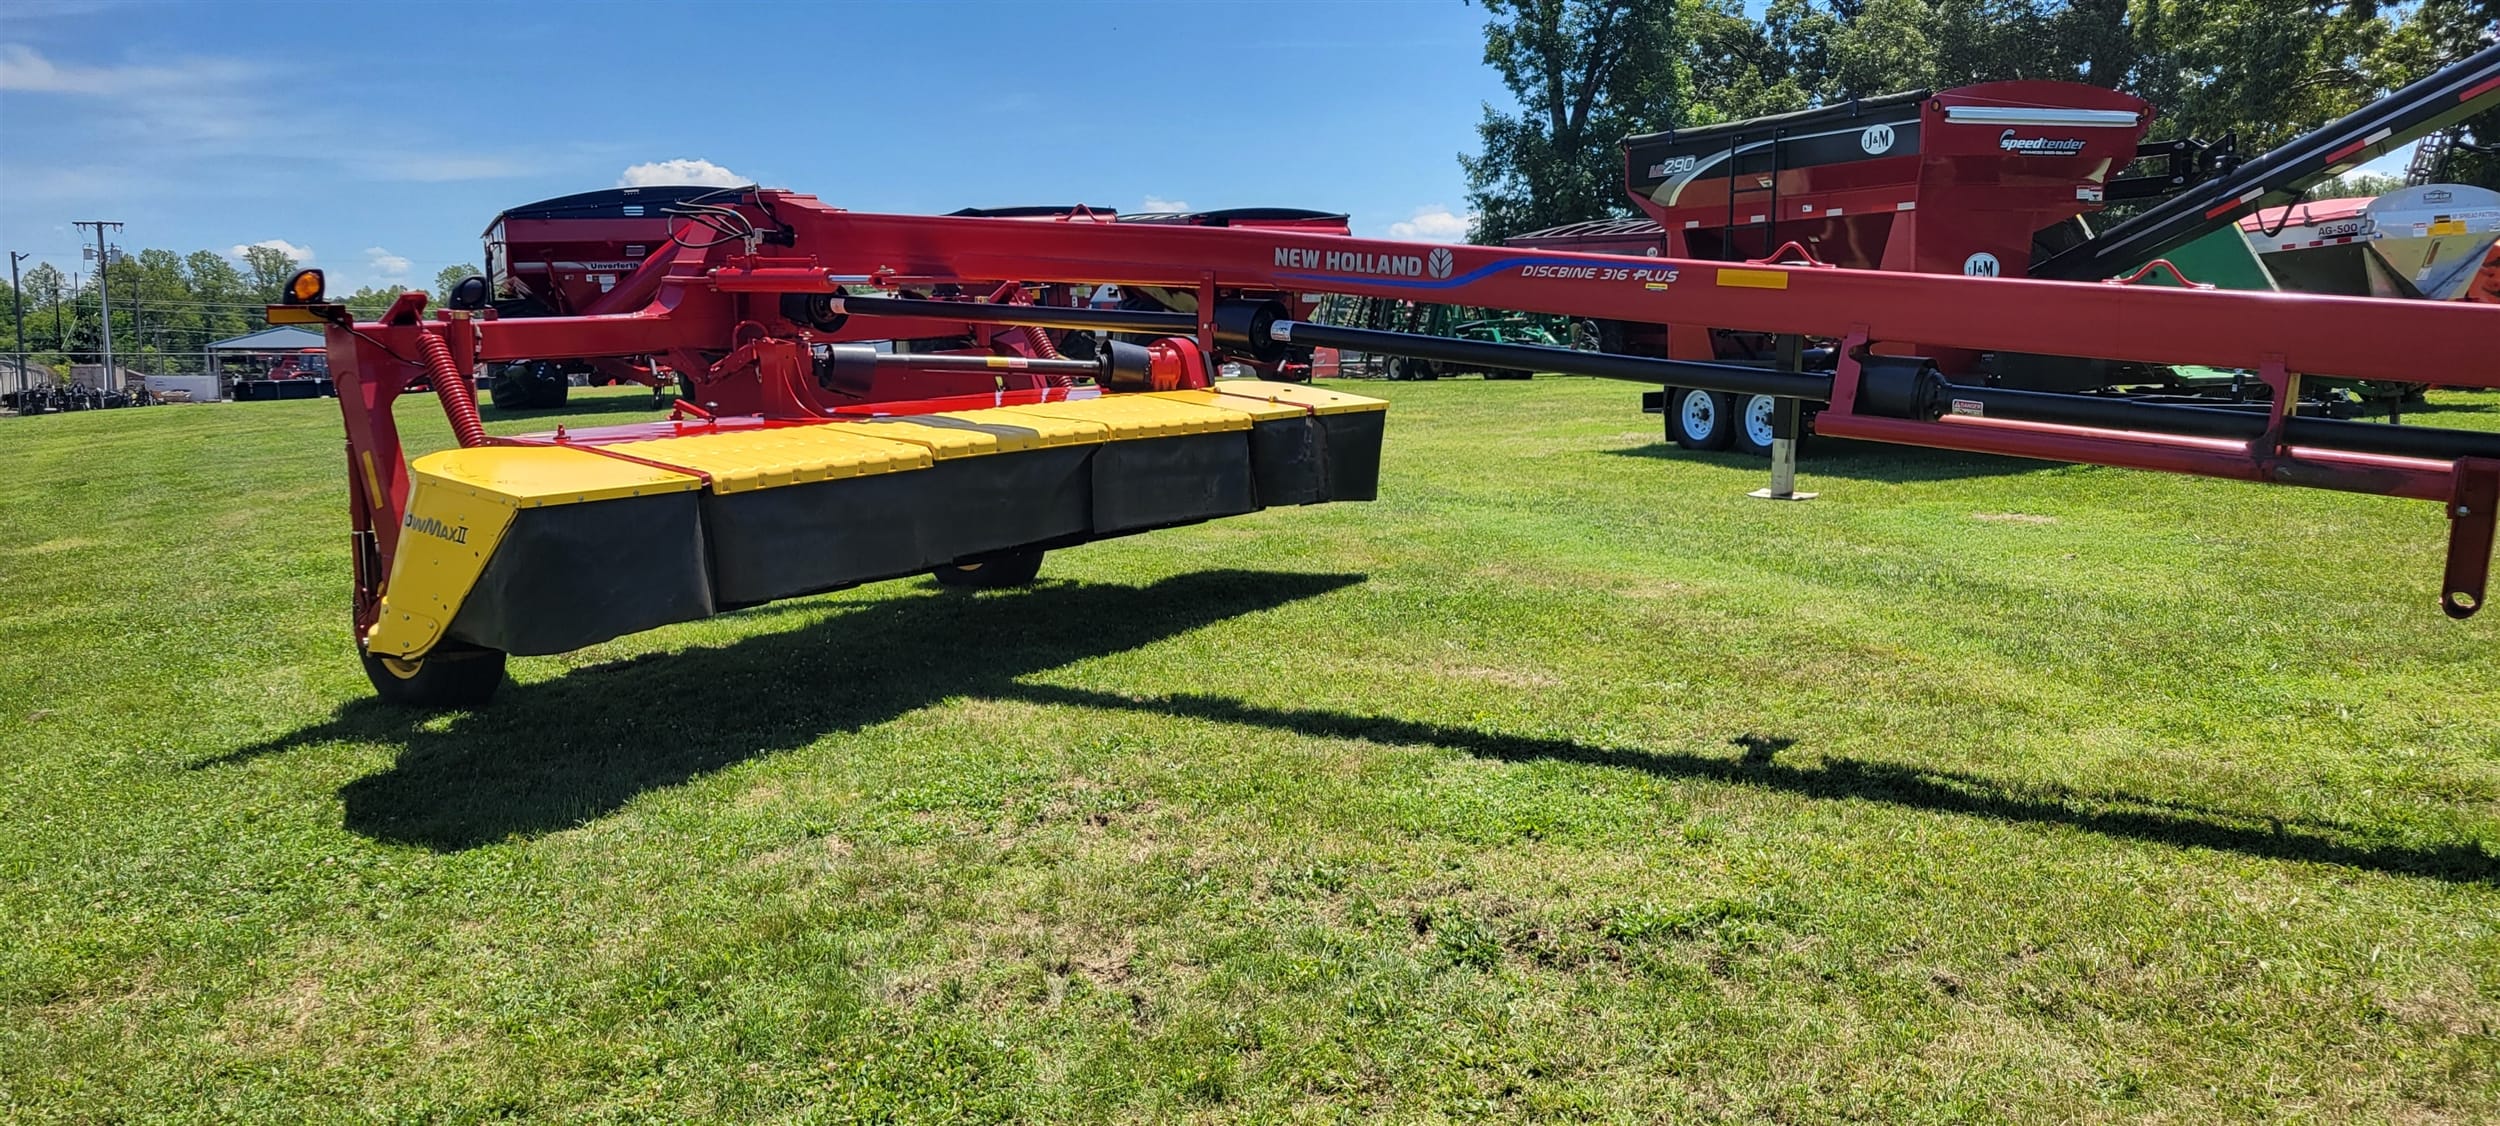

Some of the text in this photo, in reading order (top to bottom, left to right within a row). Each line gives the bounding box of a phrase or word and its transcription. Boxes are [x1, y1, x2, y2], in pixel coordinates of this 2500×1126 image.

[1864, 129, 1890, 150] J&M
[2318, 223, 2358, 236] AG-500
[1274, 247, 1422, 276] NEW HOLLAND
[1968, 260, 1994, 277] J&M
[1521, 265, 1679, 283] DISCBINE 316 PLUS
